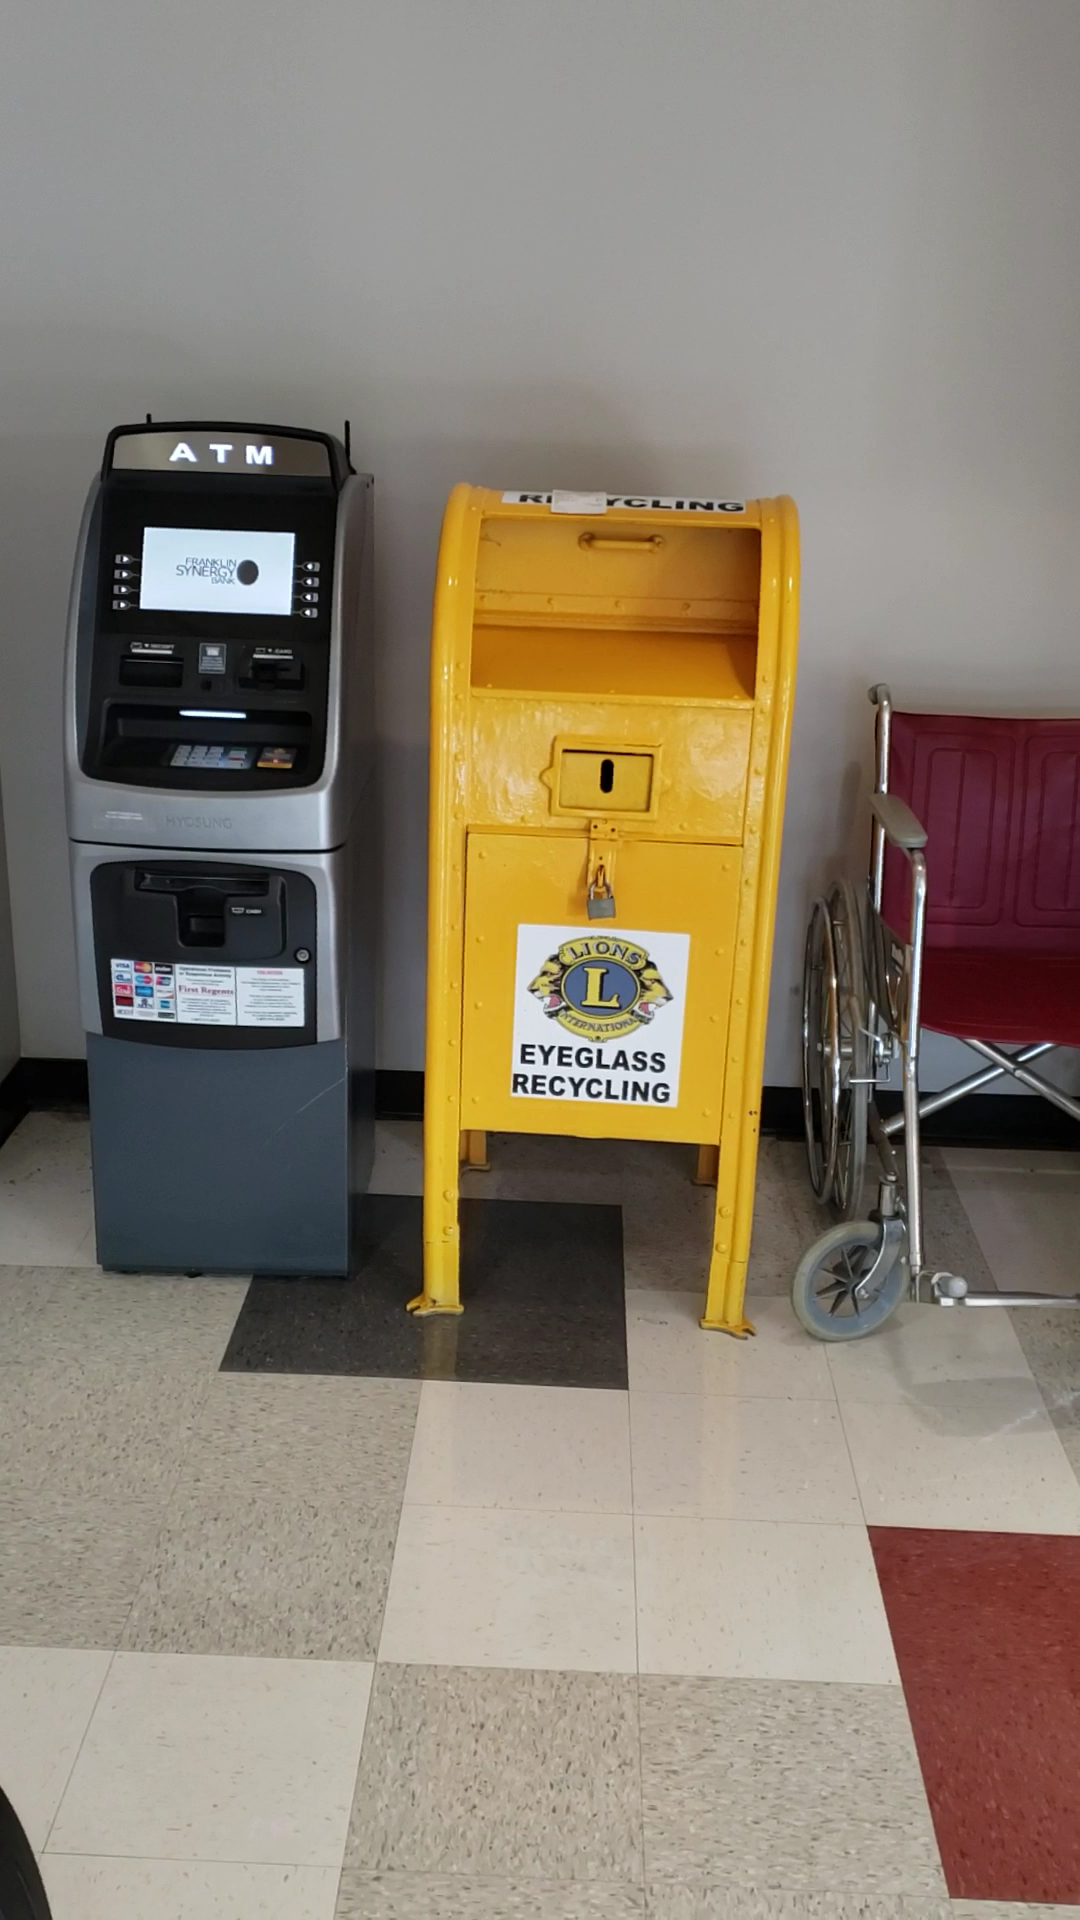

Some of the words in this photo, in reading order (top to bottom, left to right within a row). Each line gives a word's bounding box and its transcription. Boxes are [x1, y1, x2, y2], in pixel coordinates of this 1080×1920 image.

[169, 442, 273, 465] ATM
[519, 494, 744, 512] RYCLING
[185, 557, 237, 568] FRANKLIN
[175, 565, 236, 579] SYNERGY
[211, 577, 235, 585] BANK
[165, 815, 233, 829] HYOSUNG
[567, 941, 643, 966] LIONS
[178, 984, 199, 993] First
[201, 986, 234, 996] Regents
[581, 967, 621, 1009] L
[520, 1044, 666, 1073] EYEGLASS
[512, 1073, 671, 1103] RECYCLING
